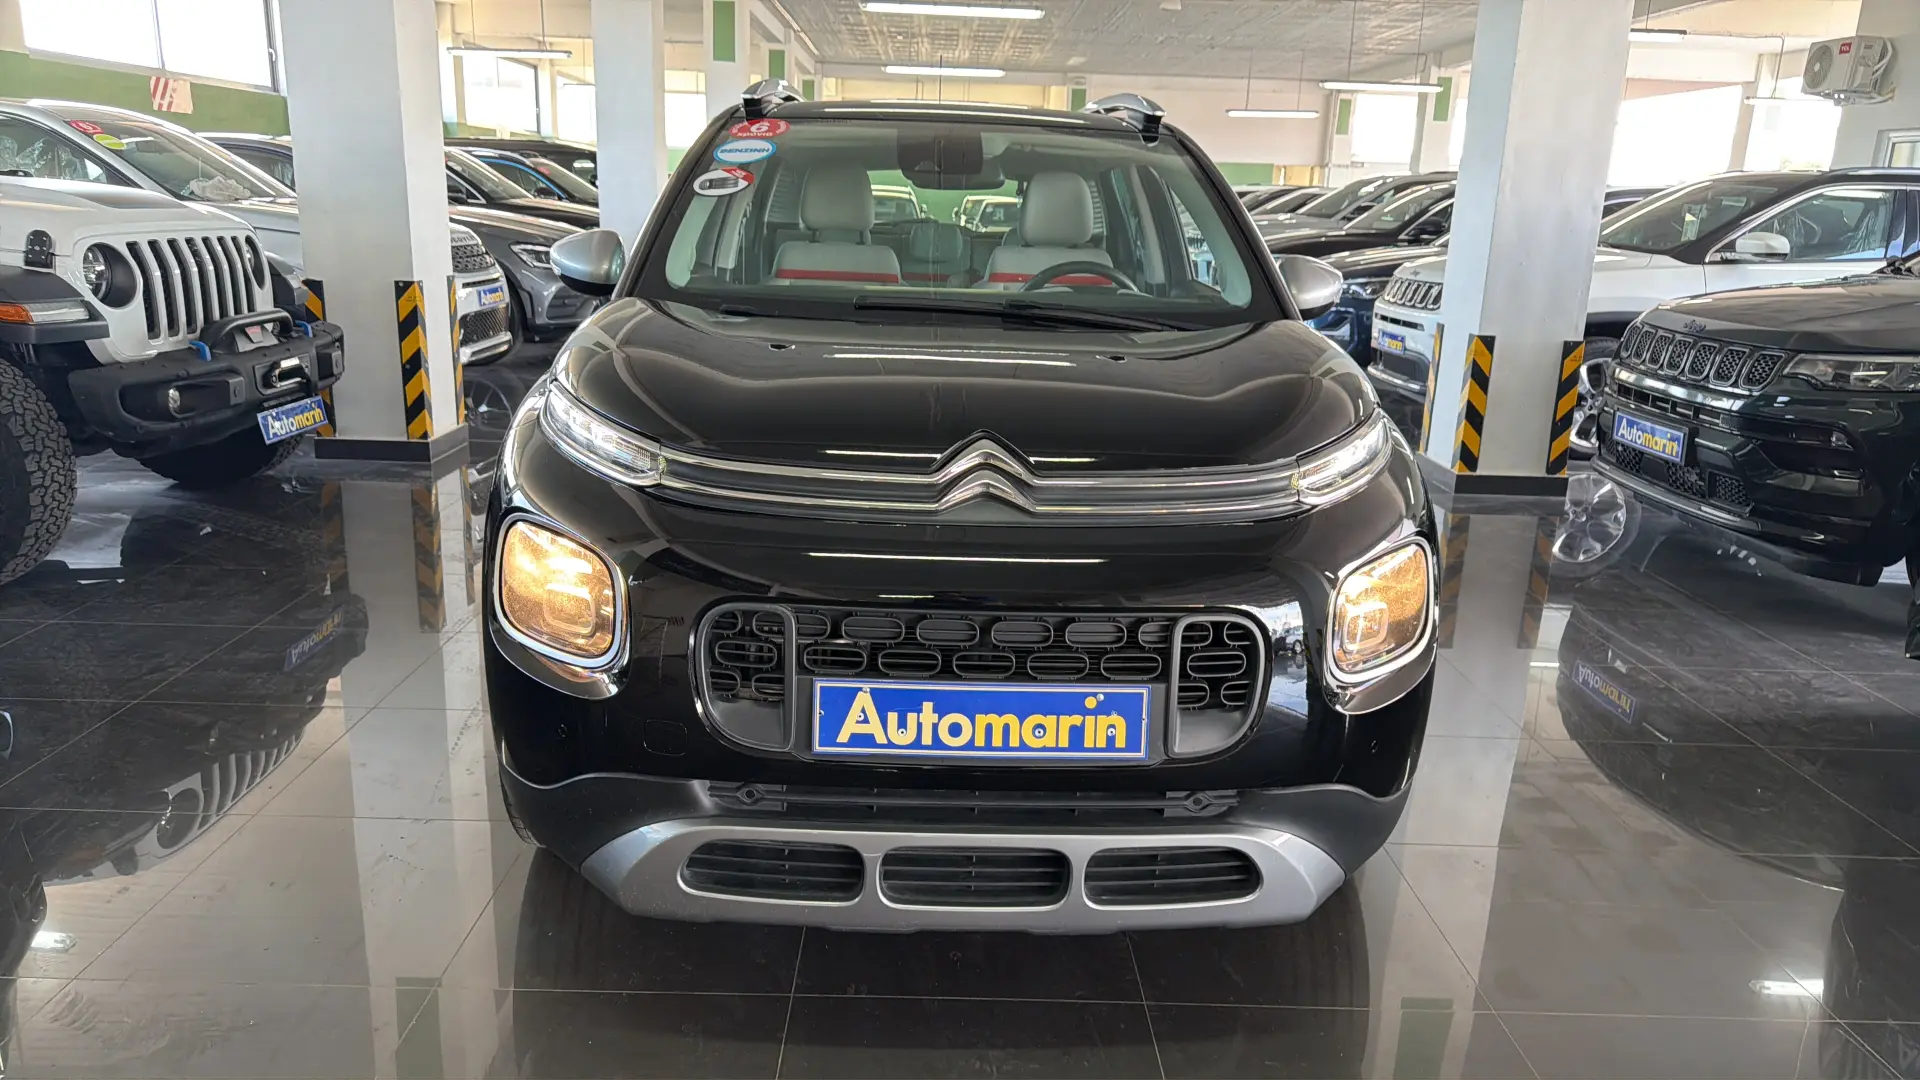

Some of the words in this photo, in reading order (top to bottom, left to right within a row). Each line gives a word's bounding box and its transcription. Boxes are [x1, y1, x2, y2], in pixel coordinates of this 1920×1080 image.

[267, 403, 324, 438] Automarin
[1618, 418, 1677, 456] Automarin
[836, 690, 1127, 748] Automarin
